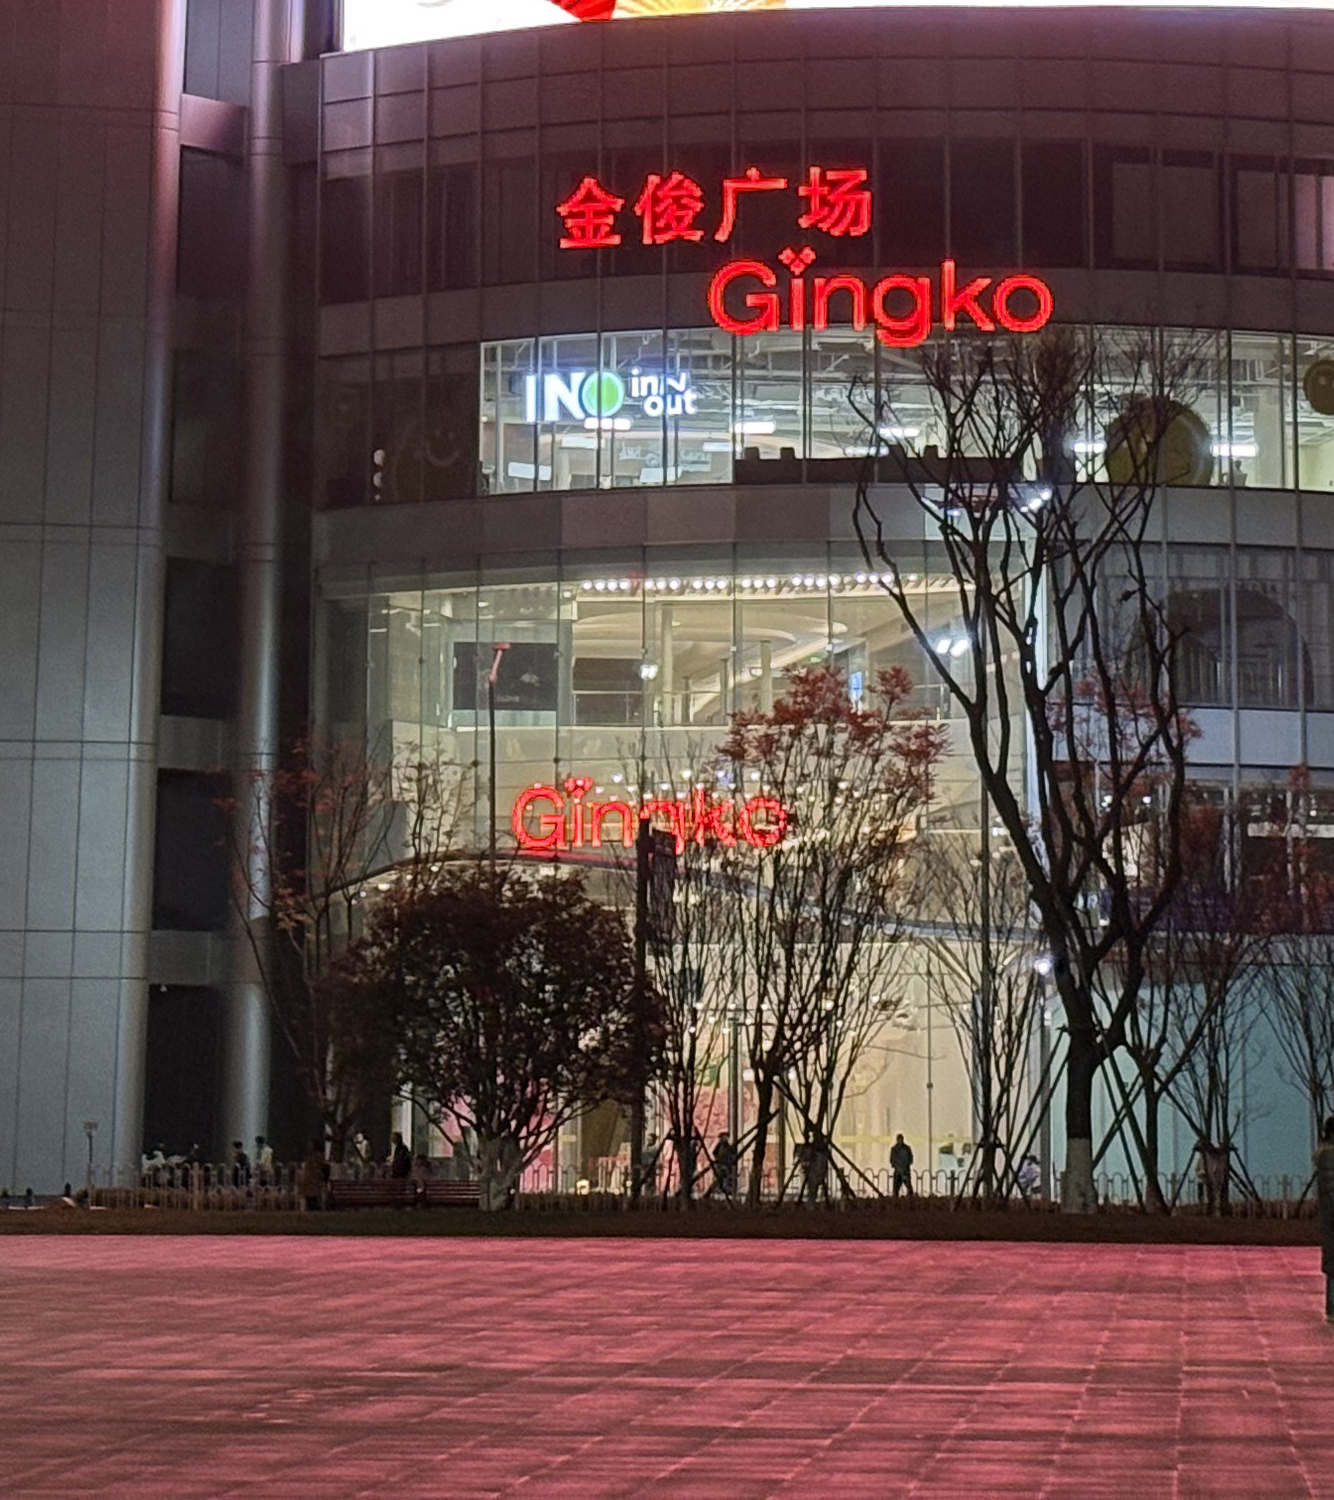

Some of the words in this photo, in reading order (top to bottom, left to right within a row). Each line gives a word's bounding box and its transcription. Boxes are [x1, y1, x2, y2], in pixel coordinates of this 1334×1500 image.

[555, 166, 872, 248] 金俊广场
[708, 247, 1054, 347] Gingko
